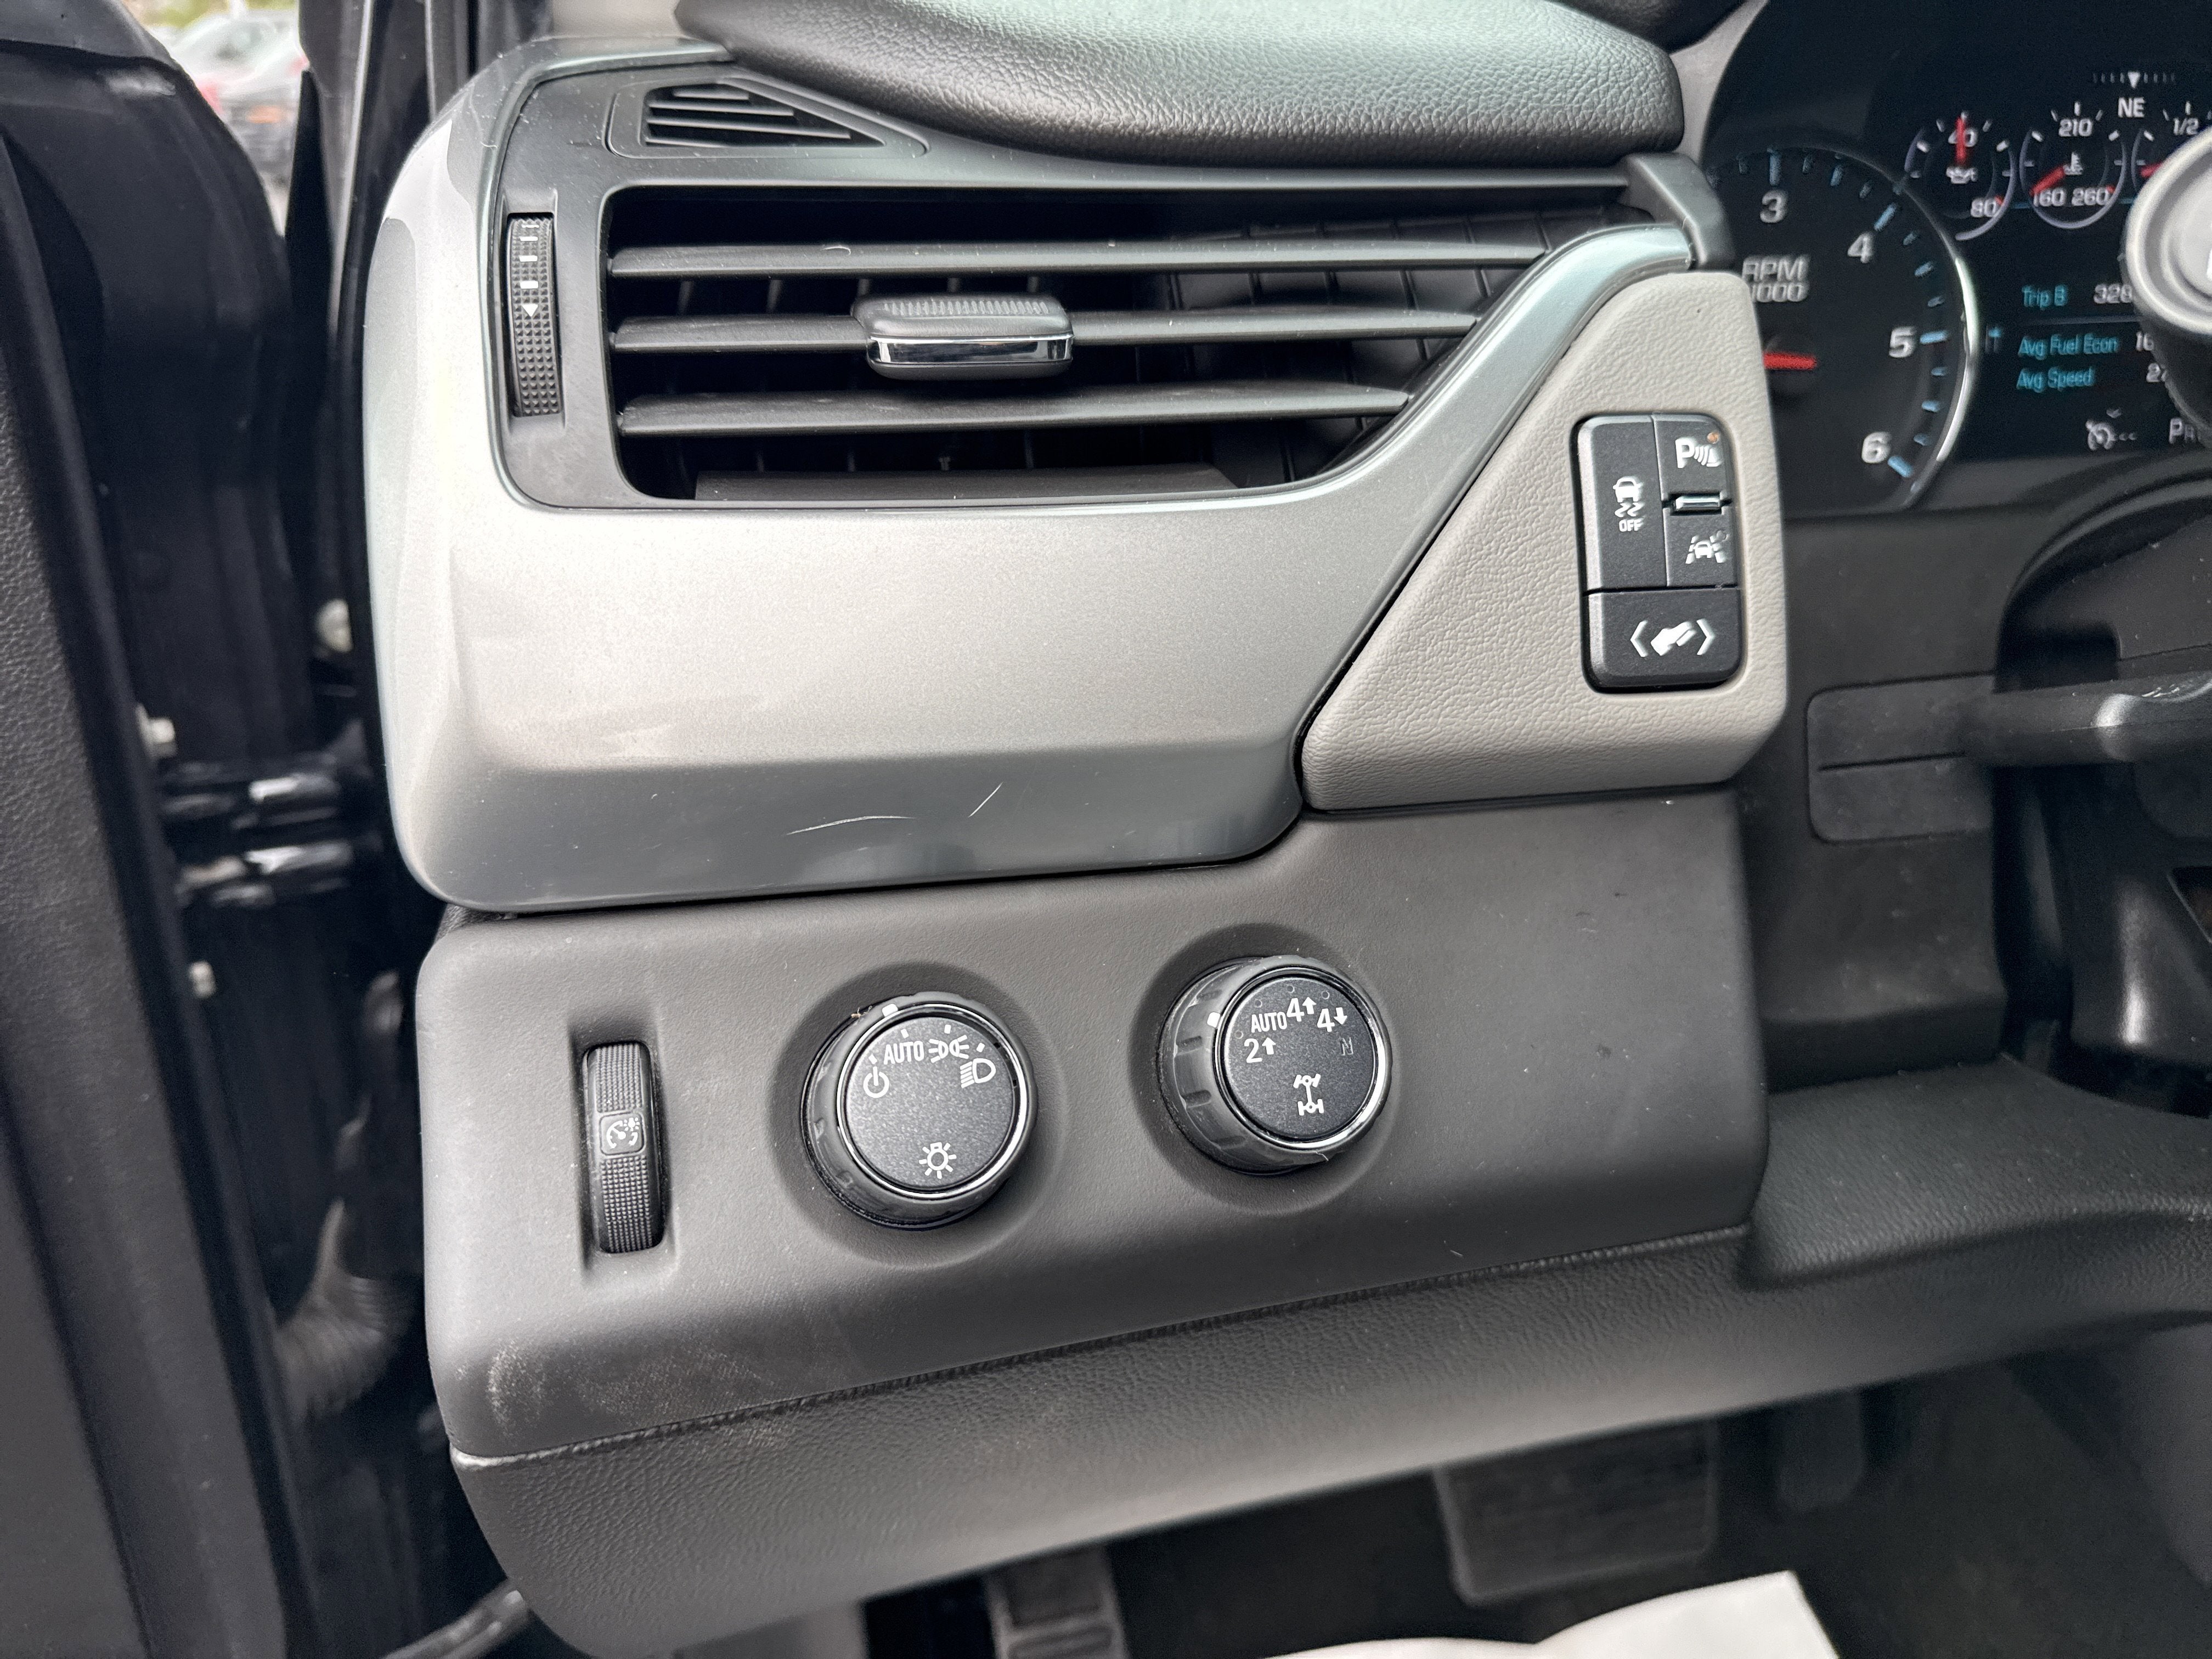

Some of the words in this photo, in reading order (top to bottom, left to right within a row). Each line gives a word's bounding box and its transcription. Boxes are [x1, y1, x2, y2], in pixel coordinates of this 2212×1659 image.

[2118, 97, 2145, 118] NE
[1948, 129, 1978, 147] 40
[2058, 117, 2093, 137] 210
[2173, 117, 2199, 136] 1/2
[1760, 189, 1788, 224] 3
[1970, 198, 1998, 218] 80
[2072, 187, 2109, 206] 260
[1847, 232, 1875, 263] 4
[1742, 255, 1810, 282] RPM
[2022, 284, 2052, 310] Trip
[2053, 284, 2068, 307] B
[1888, 326, 1917, 358] 5
[2018, 336, 2047, 360] Avg
[2050, 334, 2081, 355] Fuel
[2083, 333, 2119, 354] Econ
[2016, 368, 2045, 393] Avg
[2047, 366, 2095, 391] Speed
[1861, 431, 1892, 464] 6
[1619, 519, 1642, 532] OFF
[1251, 1012, 1288, 1033] AUTO
[883, 1040, 924, 1065] AUTO
